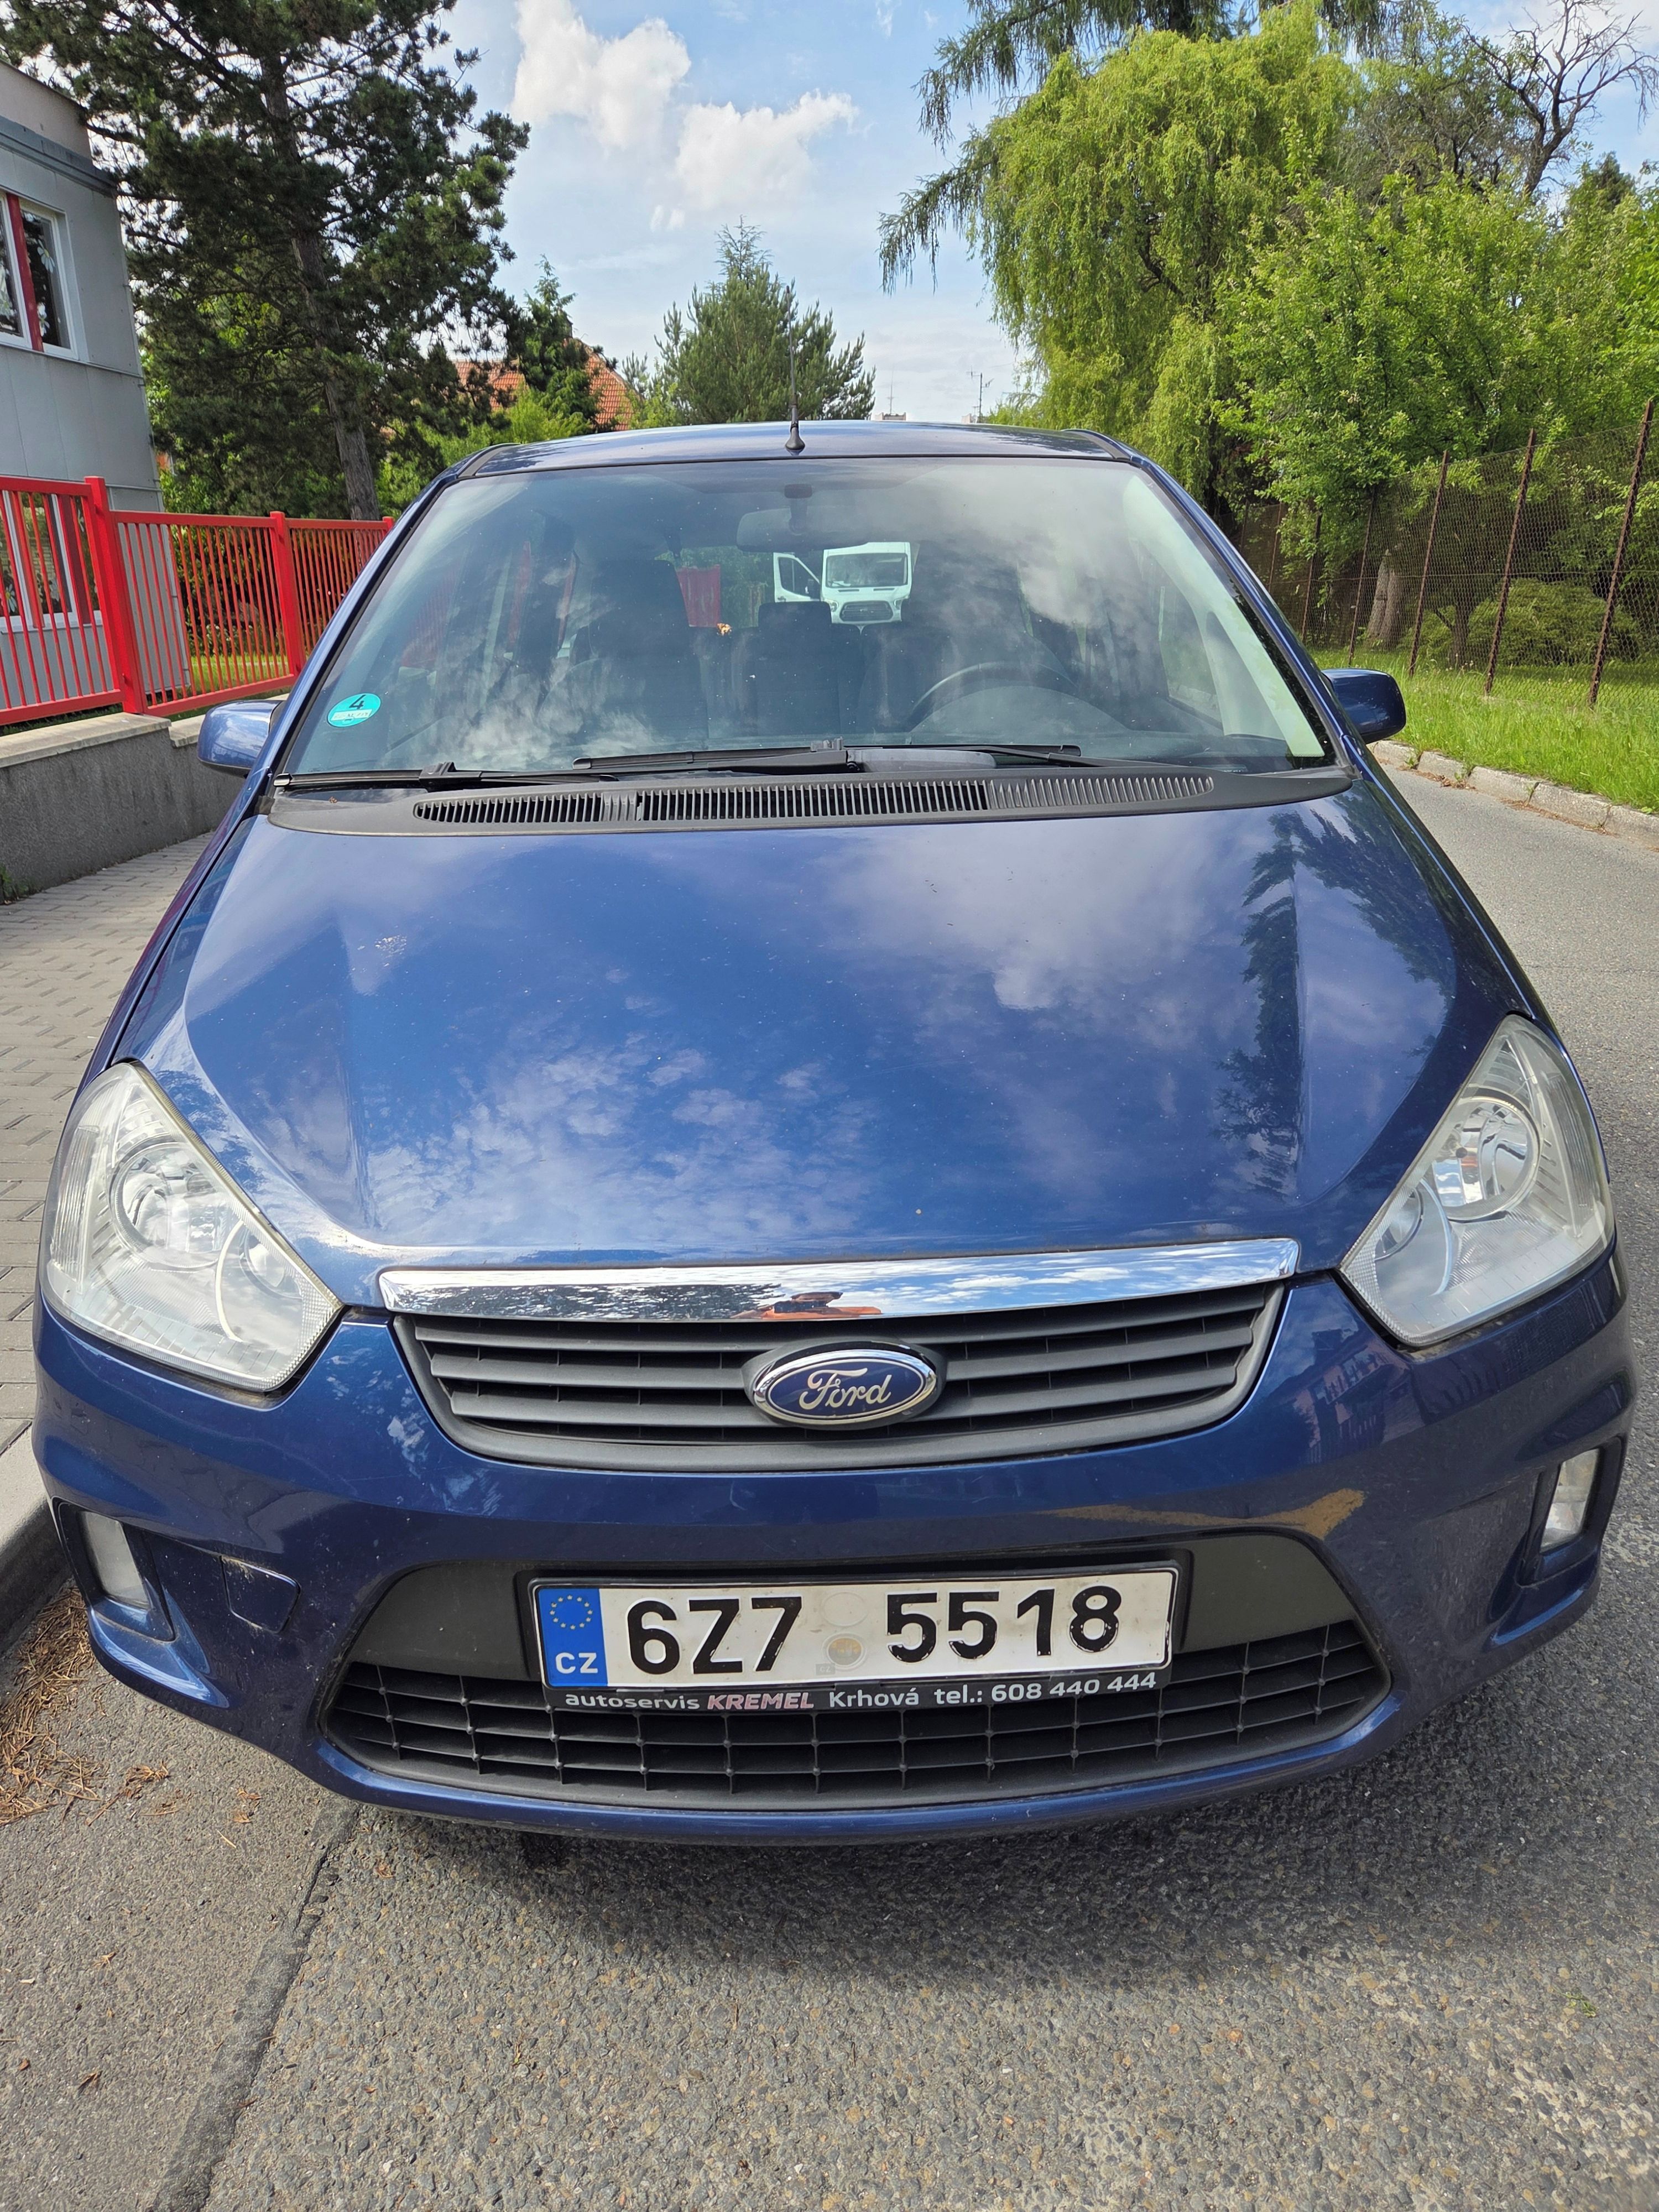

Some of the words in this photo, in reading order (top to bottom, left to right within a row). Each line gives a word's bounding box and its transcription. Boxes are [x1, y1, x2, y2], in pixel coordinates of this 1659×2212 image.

[348, 694, 366, 709] 4
[799, 1368, 892, 1410] Ford
[627, 1596, 802, 1674] 6Z7
[886, 1585, 1122, 1663] 5518
[555, 1652, 598, 1674] CZ
[565, 1693, 700, 1710] autoservis
[707, 1692, 814, 1710] KREMEL
[829, 1687, 919, 1708] Krhová
[933, 1684, 983, 1704] tel.:
[991, 1683, 1042, 1702] 608
[1050, 1679, 1100, 1697] 440
[1107, 1672, 1156, 1692] 444
